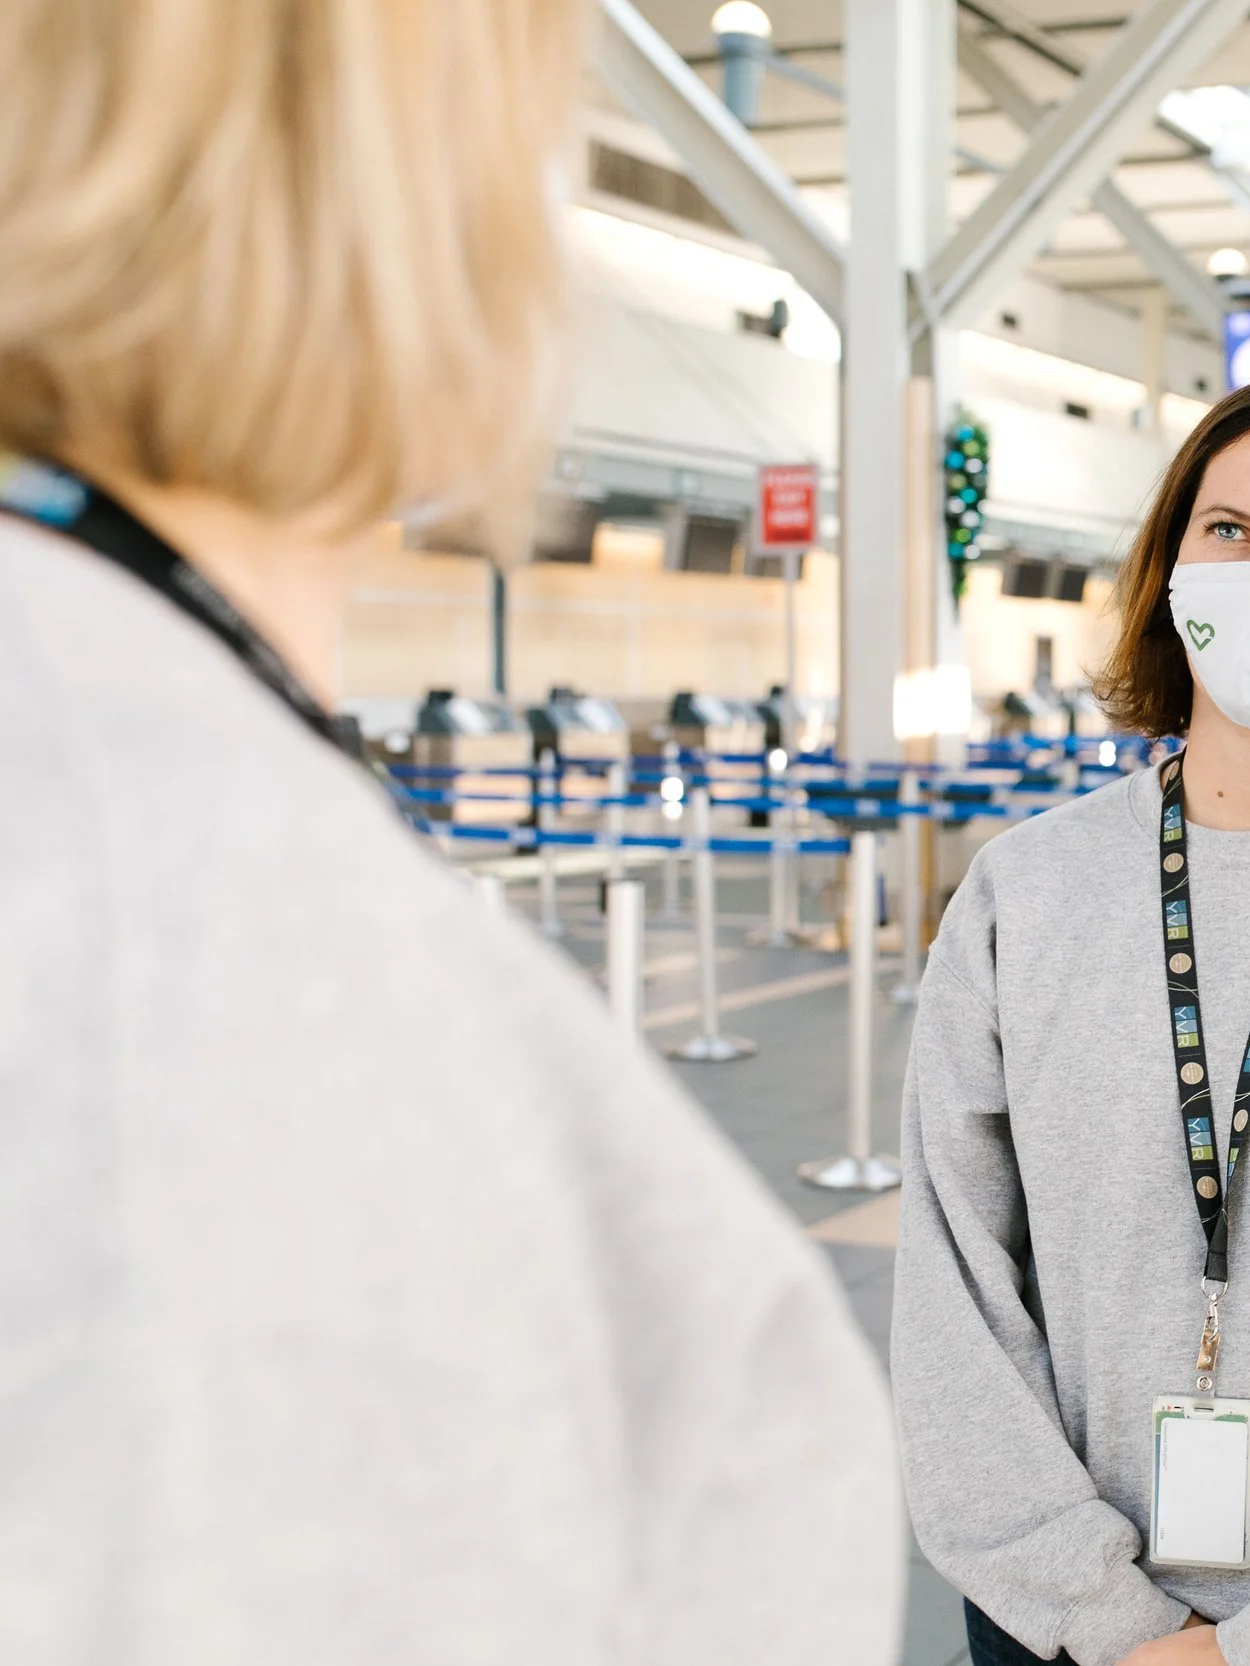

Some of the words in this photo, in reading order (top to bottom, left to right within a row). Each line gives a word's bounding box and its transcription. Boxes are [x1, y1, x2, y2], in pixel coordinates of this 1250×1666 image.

[1163, 805, 1176, 841] YVR
[1165, 900, 1179, 939] YVR
[1174, 1006, 1190, 1047] YVR
[1187, 1117, 1205, 1160] YVR
